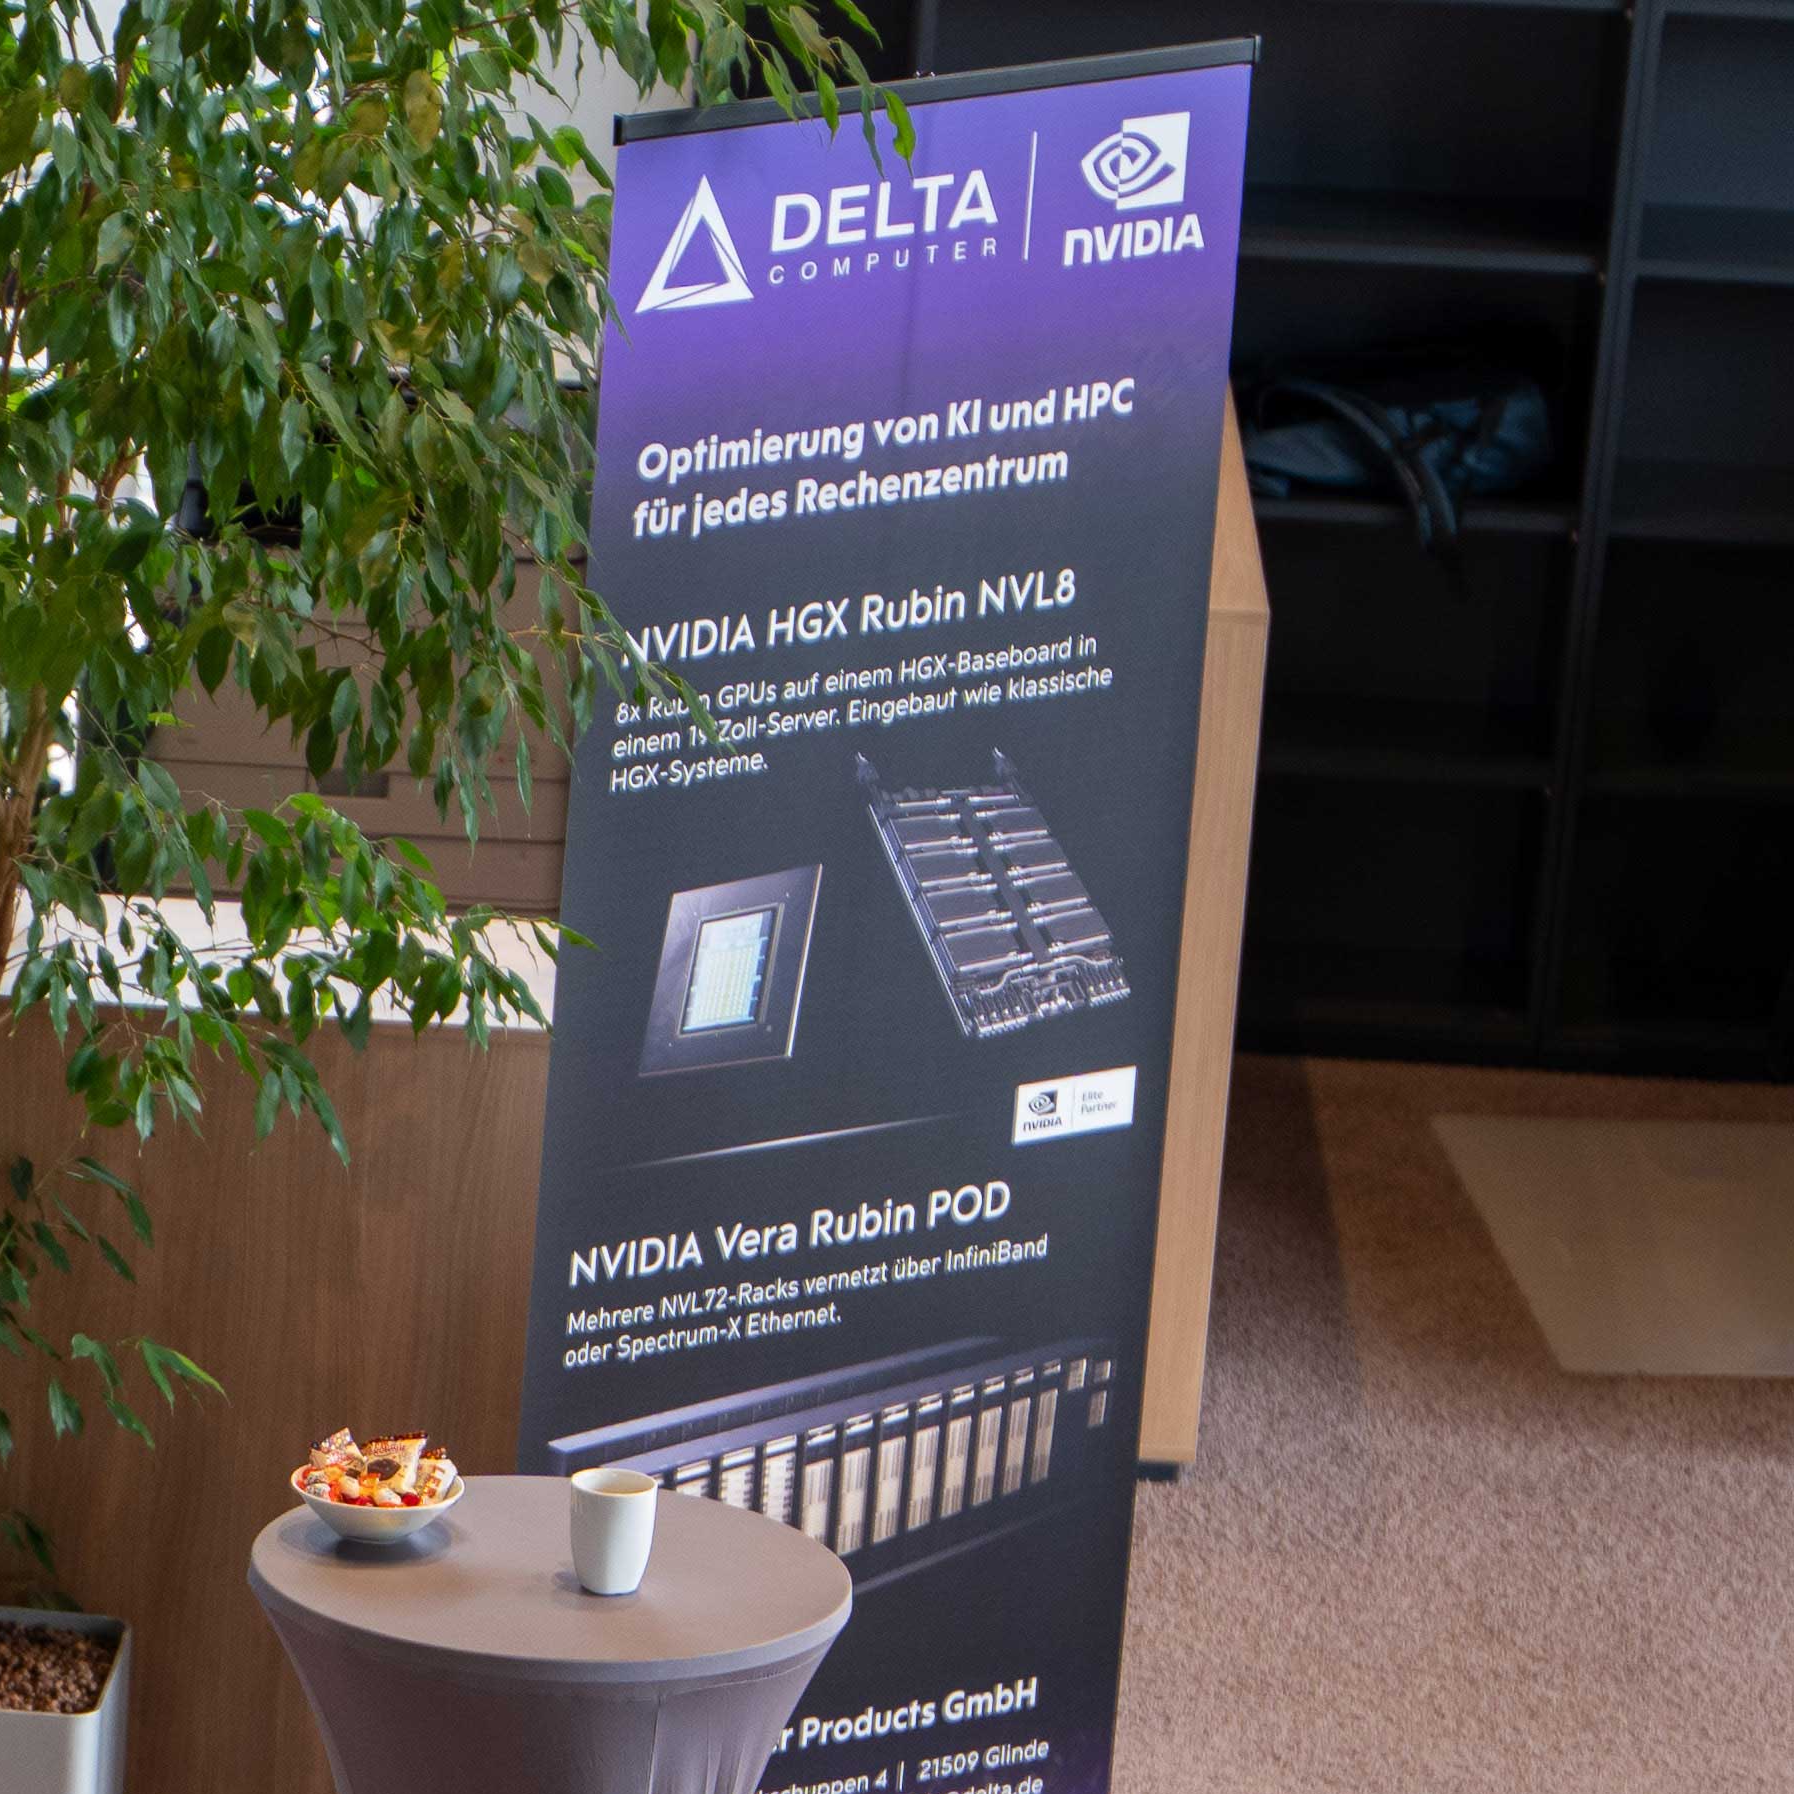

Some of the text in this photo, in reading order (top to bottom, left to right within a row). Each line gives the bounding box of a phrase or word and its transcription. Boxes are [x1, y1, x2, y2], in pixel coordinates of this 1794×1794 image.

[772, 170, 999, 252] DELTA
[1064, 214, 1205, 267] NVIDIA
[770, 237, 997, 285] COMPUTER
[639, 377, 1135, 485] Optimierung von KI und HPC
[634, 450, 1069, 537] für jedes Rechenzentrum
[769, 599, 849, 648] HGX
[862, 585, 966, 633] Rubin
[980, 568, 1077, 617] NVL8
[614, 731, 681, 759] einem
[849, 688, 959, 726] Eingebaut
[965, 682, 1003, 706] wie
[1009, 668, 1114, 701] klassische
[616, 701, 641, 726] 8x
[719, 679, 776, 710] GPUs
[784, 669, 819, 698] auf
[825, 665, 893, 692] einem
[901, 637, 1073, 685] HGX-Baseboard
[1079, 634, 1098, 658] in
[611, 751, 769, 794] HGX-Systeme.
[571, 1181, 1012, 1288] NVIDIA Vera Rubin POD
[568, 1231, 1050, 1336] Mehrere NVL72-Racks vernetzt über InfiniBand
[565, 1302, 843, 1369] oder Spectrum-X Ethernet.
[802, 1699, 937, 1748] Products
[944, 1676, 1039, 1723] GmbH
[874, 1768, 889, 1790] 4
[919, 1751, 981, 1783] 21509
[986, 1738, 1051, 1770] Glinde
